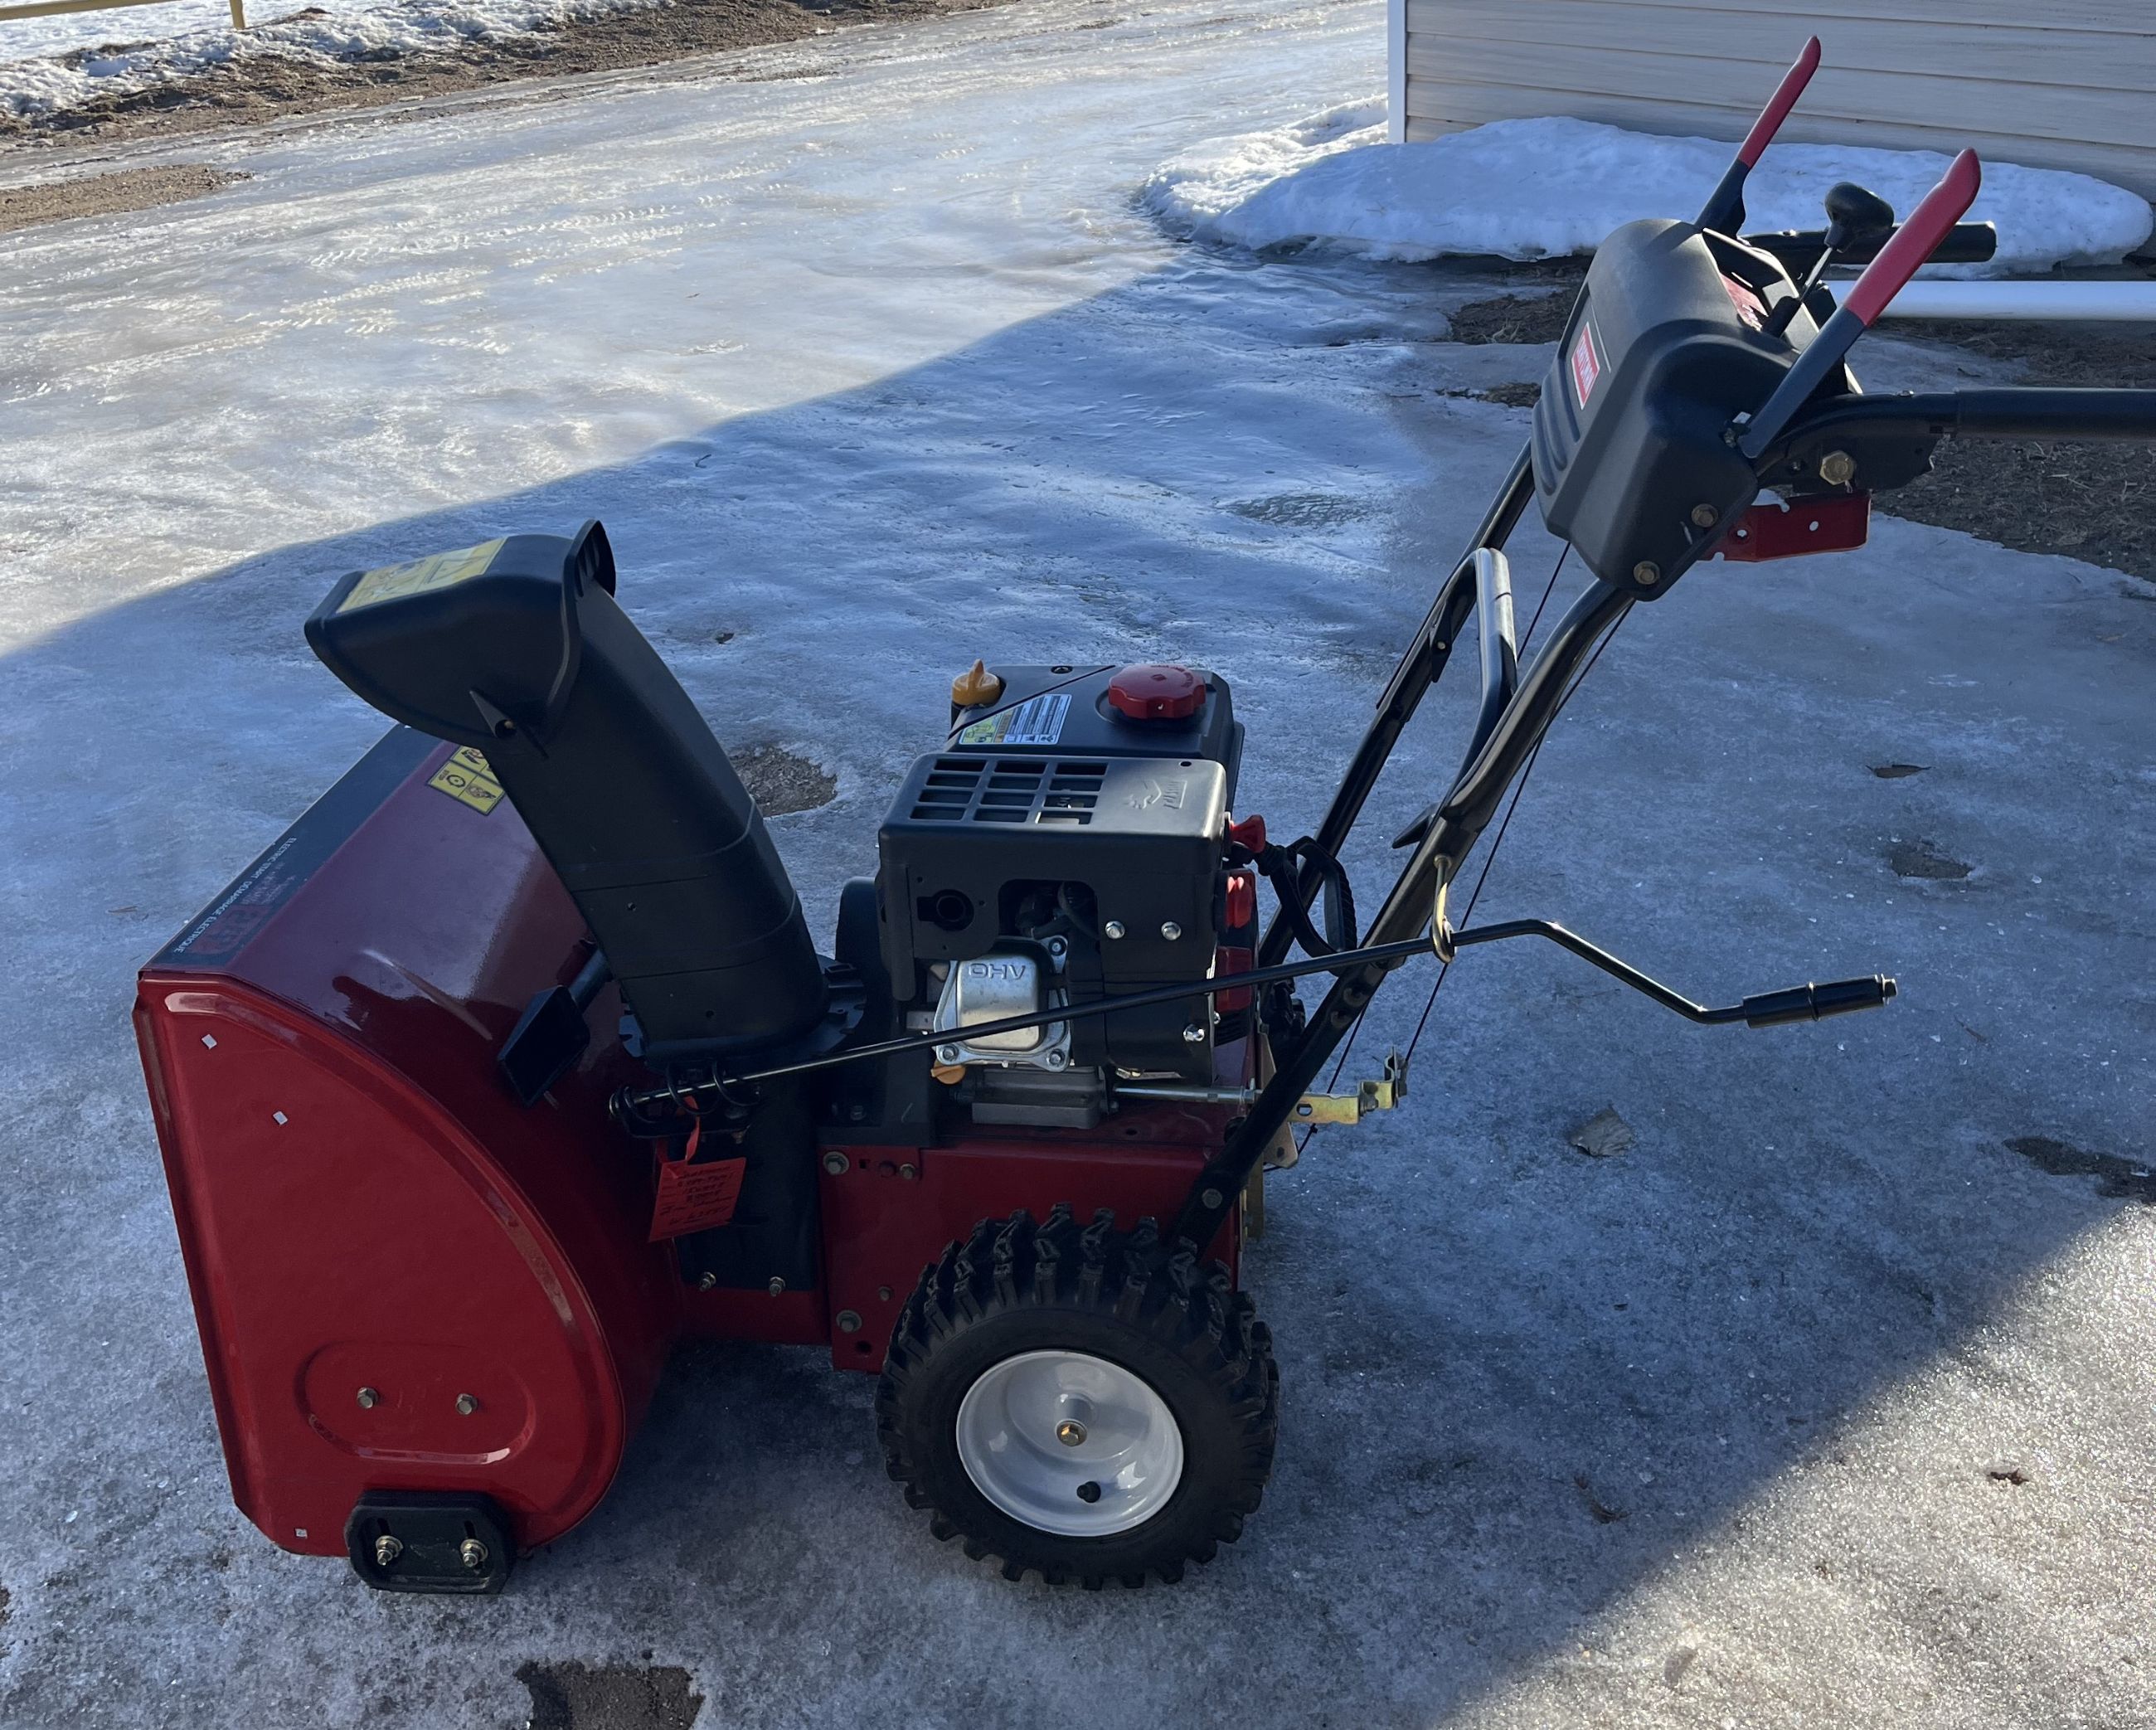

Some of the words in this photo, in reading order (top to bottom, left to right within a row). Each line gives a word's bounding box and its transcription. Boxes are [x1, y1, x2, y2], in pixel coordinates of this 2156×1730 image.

[269, 838, 297, 862] ELECTRIC
[251, 862, 273, 878] START
[969, 963, 1026, 979] OHV
